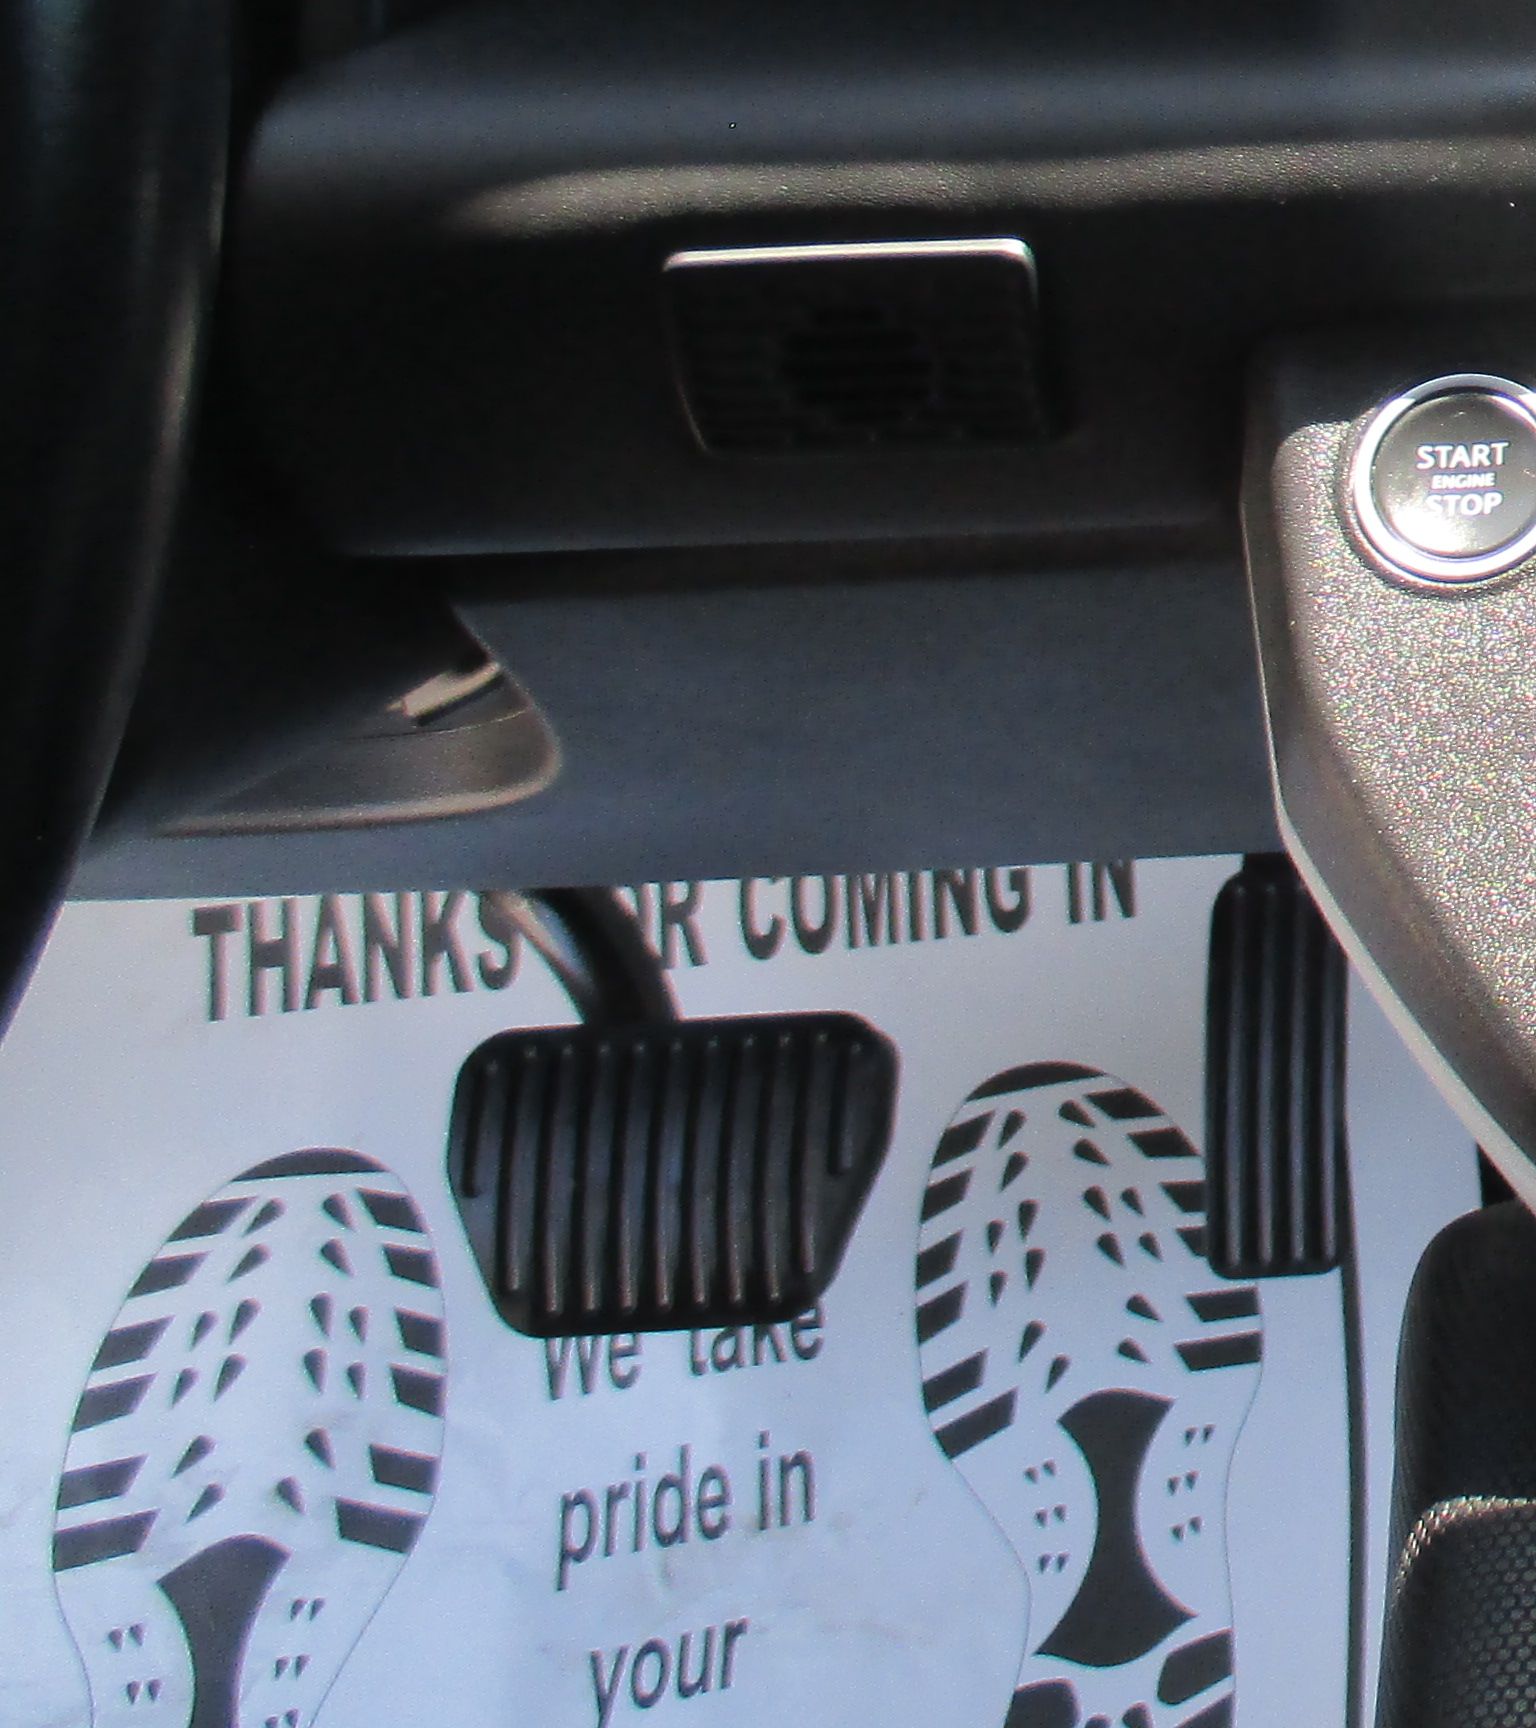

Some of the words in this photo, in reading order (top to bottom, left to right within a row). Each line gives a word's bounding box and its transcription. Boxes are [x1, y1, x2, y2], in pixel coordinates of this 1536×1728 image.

[1416, 441, 1510, 470] START
[1430, 472, 1496, 490] ENGINE
[1424, 491, 1503, 517] STOP
[191, 889, 525, 1023] THANKS
[738, 863, 1033, 961] COMING
[1066, 859, 1138, 922] IN
[555, 1443, 732, 1592] pride
[756, 1429, 818, 1531] in
[589, 1616, 750, 1728] your
